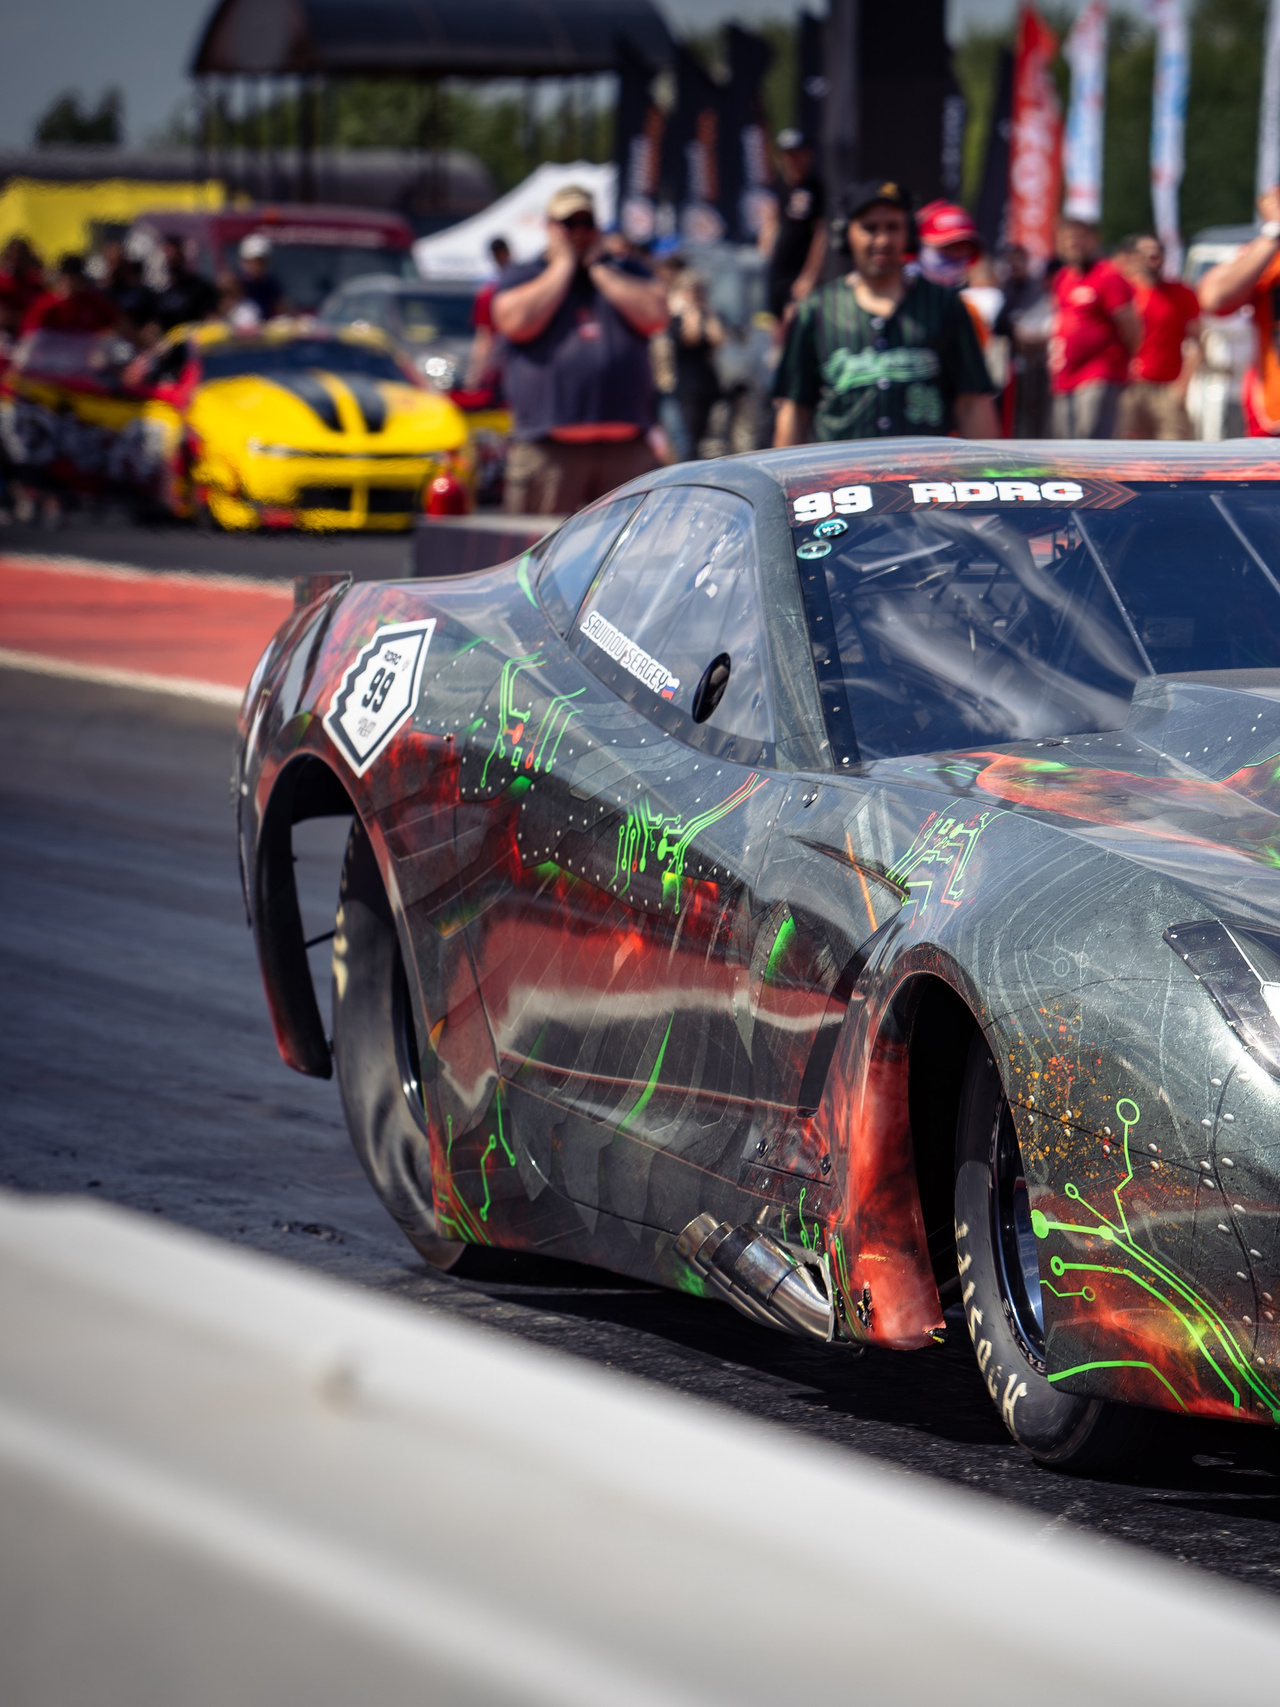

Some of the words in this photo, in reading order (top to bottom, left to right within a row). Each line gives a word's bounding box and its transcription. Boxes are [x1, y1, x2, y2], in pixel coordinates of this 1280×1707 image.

[793, 485, 874, 522] 99
[909, 481, 1084, 503] RDRC
[622, 647, 669, 690] SERGEY
[361, 667, 396, 714] 99
